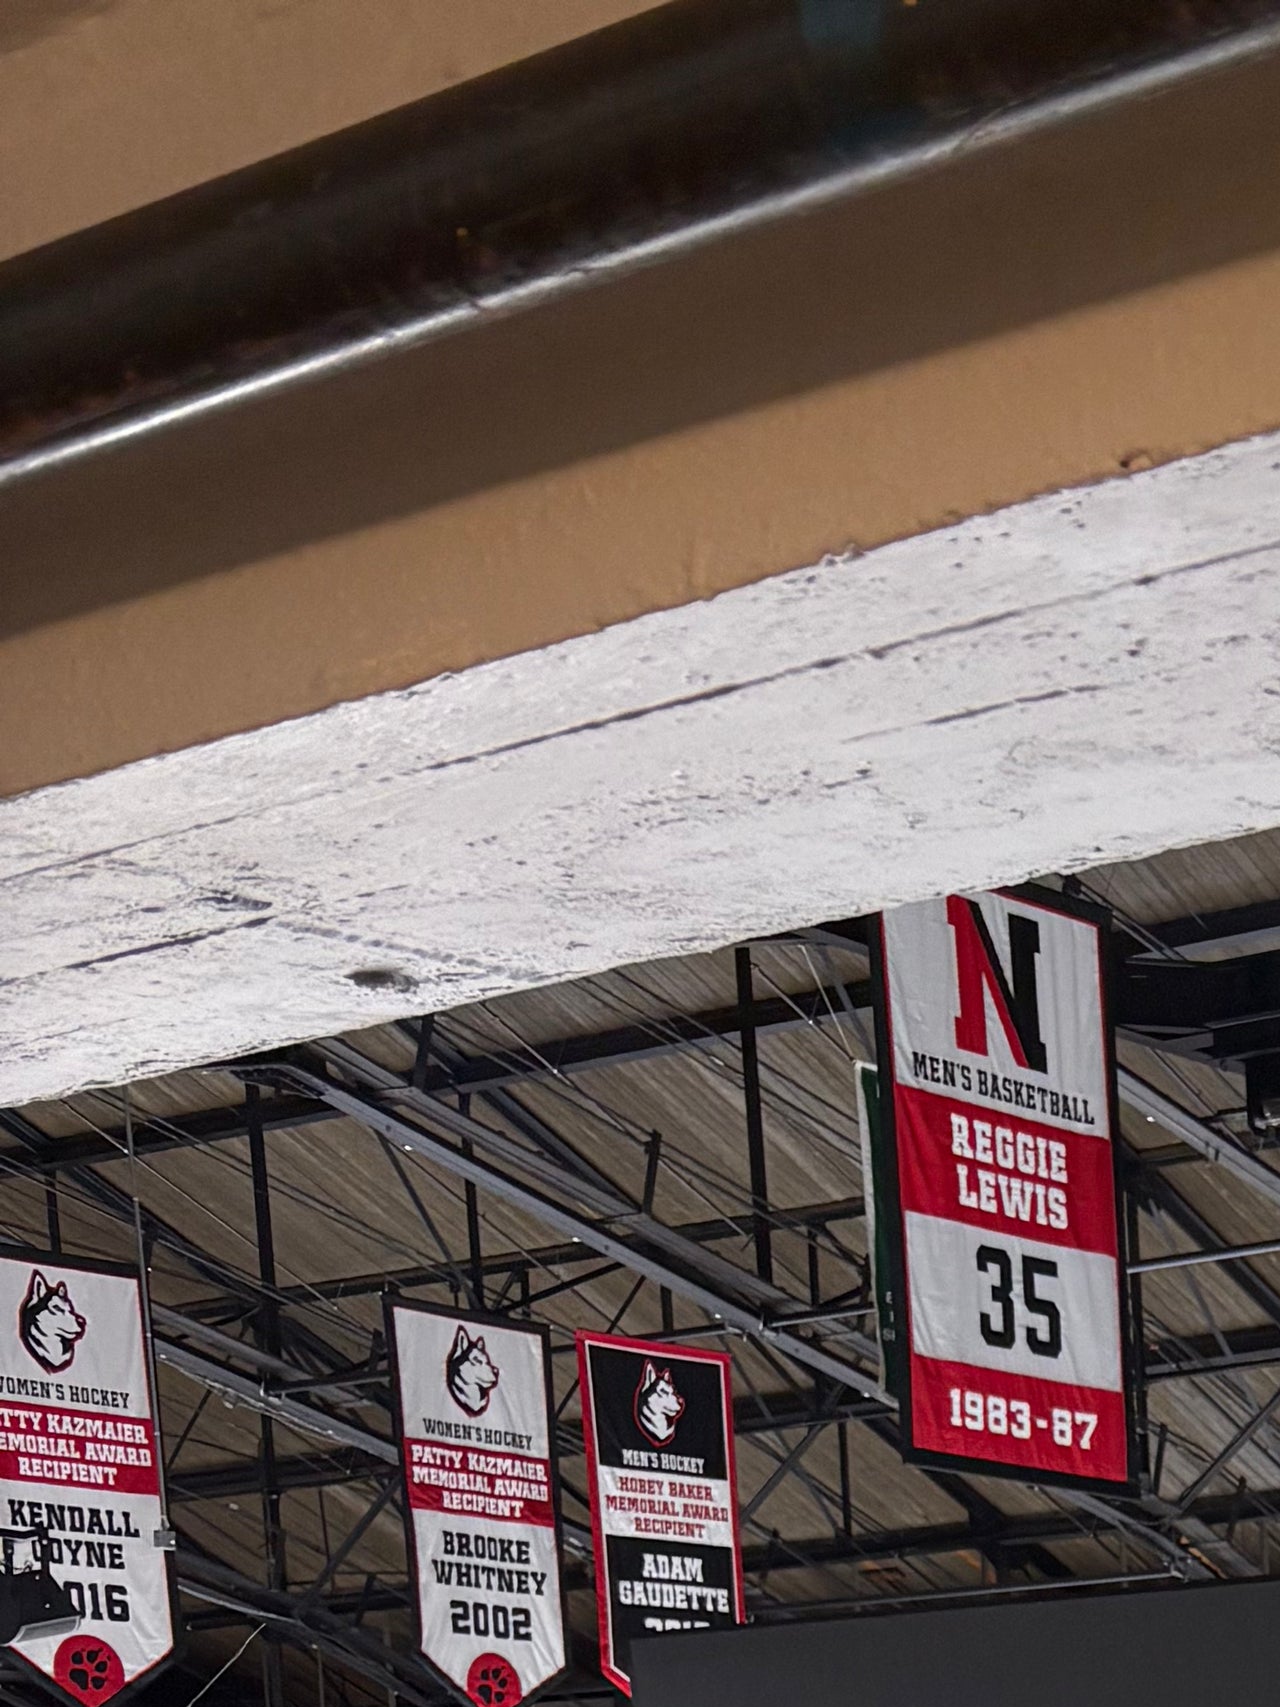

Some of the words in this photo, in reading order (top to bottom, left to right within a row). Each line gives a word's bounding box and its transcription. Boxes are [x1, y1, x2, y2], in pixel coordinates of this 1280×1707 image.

[946, 894, 1048, 1075] N
[912, 1050, 972, 1093] MEN'S
[977, 1064, 1095, 1125] BASKETBALL
[949, 1112, 1068, 1184] REGGIE
[957, 1162, 1069, 1230] LEWIS
[975, 1244, 1063, 1360] 35
[69, 1384, 130, 1409] HOCKEY
[0, 1408, 42, 1431] TTY
[46, 1413, 149, 1445] KAZMAIER
[423, 1418, 483, 1443] WOMEN'S
[484, 1429, 532, 1451] HOCKEY
[949, 1387, 1099, 1451] 1983-87
[0, 1431, 81, 1459] EMORIAL
[85, 1442, 152, 1467] AWARD
[411, 1444, 463, 1469] PATTY
[467, 1452, 548, 1482] KAZMAIER
[622, 1449, 658, 1469] MEN'S
[661, 1452, 705, 1474] HOCKEY
[18, 1456, 117, 1486] RECIPIENT
[412, 1466, 491, 1494] MEMORIAL
[494, 1479, 548, 1502] AWARD
[618, 1476, 664, 1496] HOBEY
[668, 1482, 713, 1502] BAKER
[8, 1499, 140, 1538] KENDALL
[442, 1491, 524, 1517] RECIPIENT
[605, 1494, 679, 1517] MEMORIAL
[682, 1504, 729, 1522] AWARD
[634, 1517, 705, 1538] RECIPIENT
[442, 1530, 530, 1564] BROOKE
[432, 1560, 547, 1596] WHITNEY
[642, 1553, 704, 1582] ADAM
[63, 1581, 130, 1622] 016
[618, 1580, 730, 1613] GAUDETTE
[450, 1599, 532, 1641] 2002
